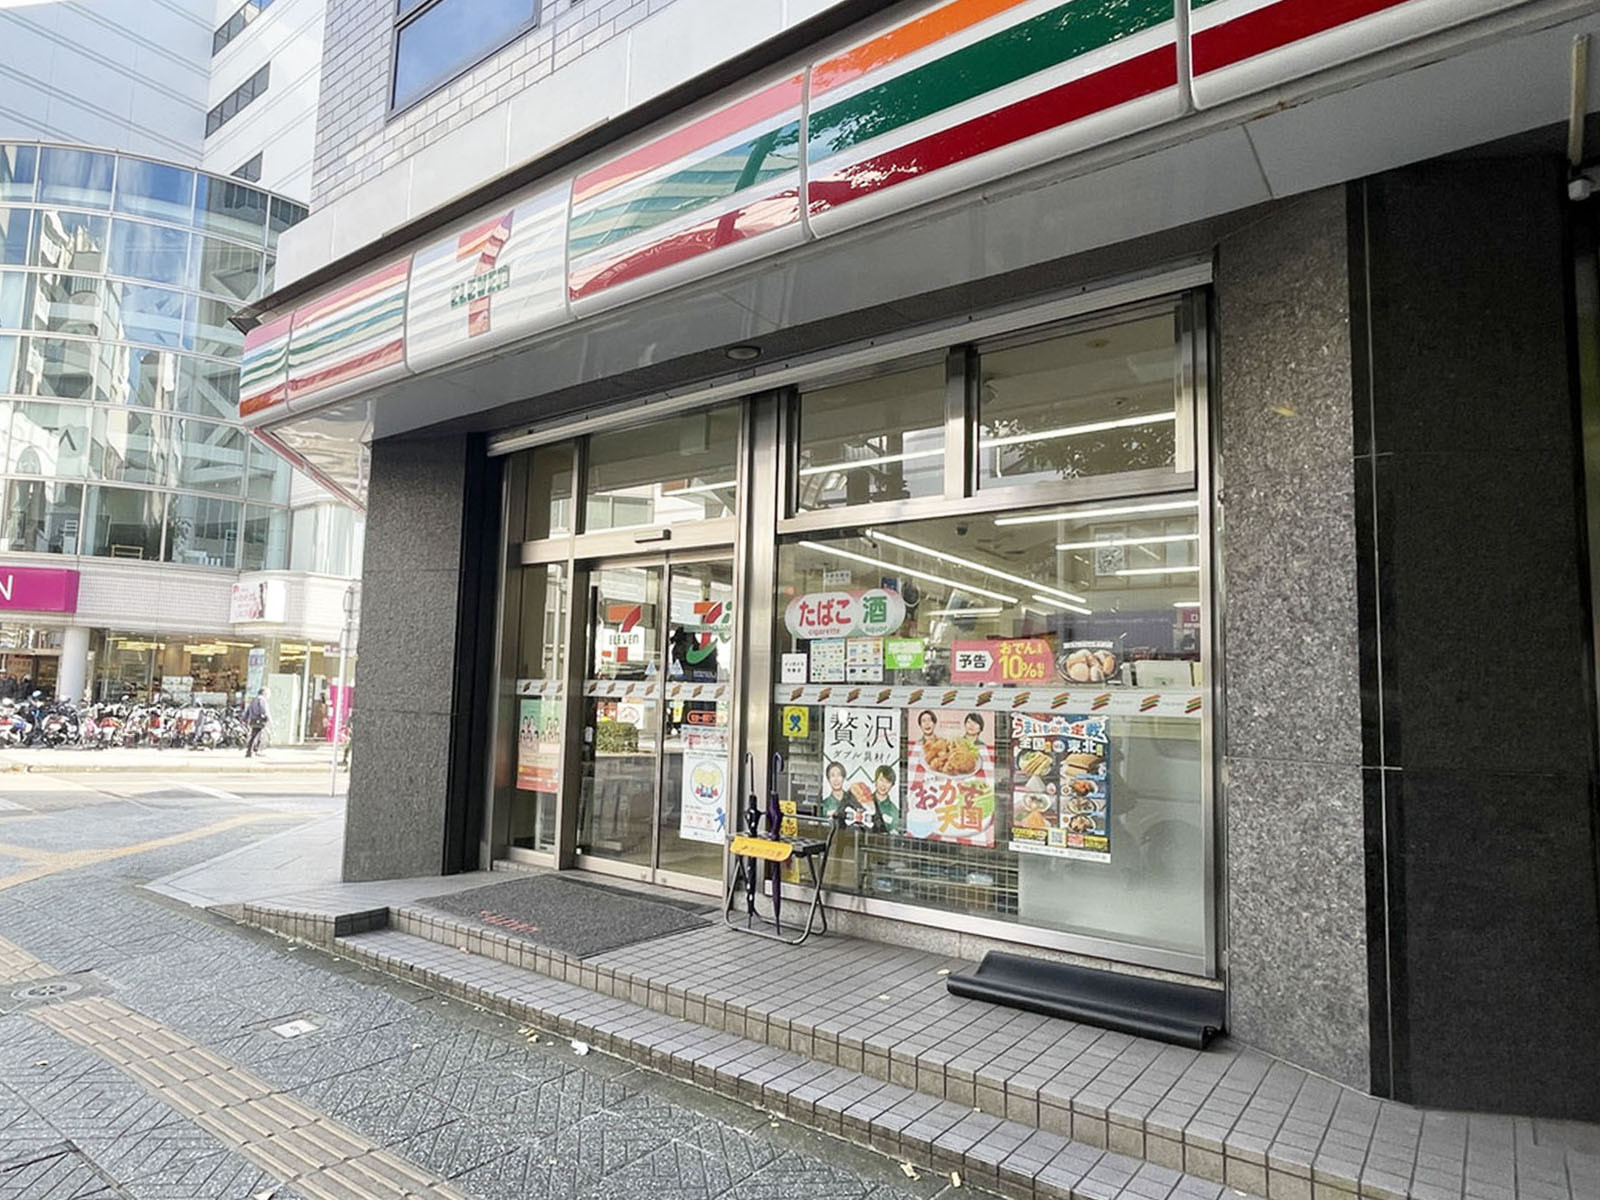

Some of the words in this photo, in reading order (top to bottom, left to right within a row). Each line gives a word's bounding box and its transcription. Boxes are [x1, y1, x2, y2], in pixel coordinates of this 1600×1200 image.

[799, 598, 852, 626] たばこ
[862, 595, 888, 624] 酒
[958, 654, 987, 669] 予告
[830, 712, 894, 749] 贅沢
